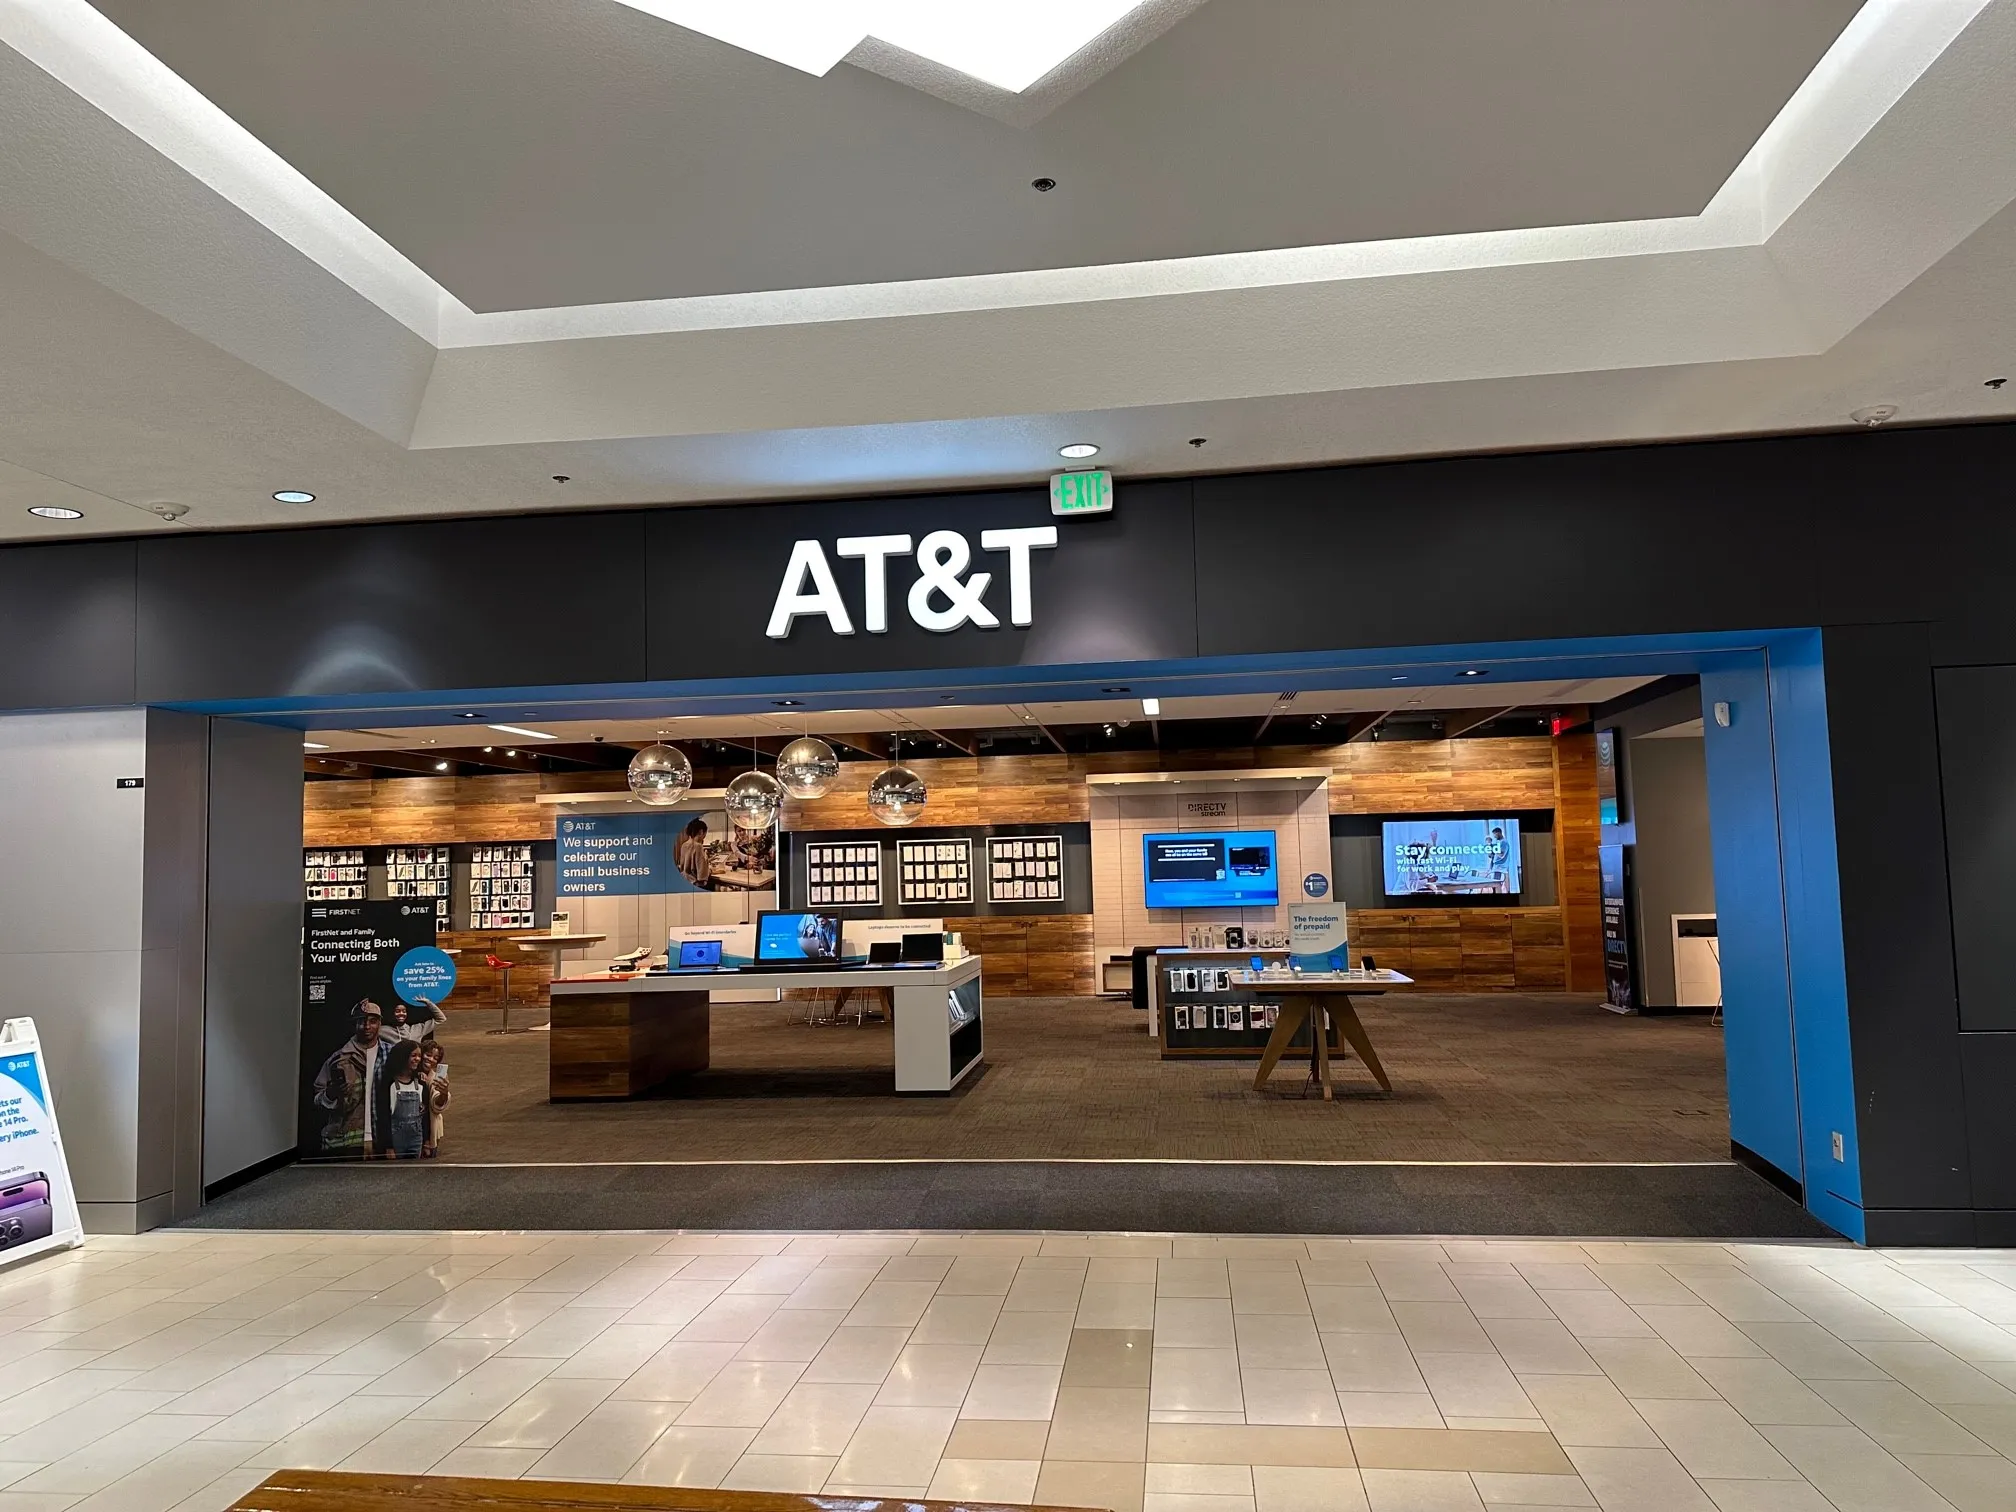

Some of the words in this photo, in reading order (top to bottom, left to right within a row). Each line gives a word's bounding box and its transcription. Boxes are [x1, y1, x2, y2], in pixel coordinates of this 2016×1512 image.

[1060, 472, 1103, 510] EXIT
[765, 525, 1058, 639] AT&T
[125, 779, 136, 787] 179
[1188, 803, 1226, 812] DIRECTV
[575, 822, 596, 831] AT&T
[563, 837, 581, 848] We
[584, 836, 630, 849] support
[632, 835, 653, 846] and
[1395, 844, 1427, 858] Stay
[1429, 842, 1501, 855] connected
[563, 852, 616, 863] celebrate
[619, 852, 638, 861] our
[1396, 857, 1416, 865] with
[1416, 857, 1434, 865] fast
[1435, 856, 1457, 864] Wi-Fi
[563, 867, 595, 878] small
[597, 866, 650, 877] business
[1411, 864, 1433, 872] work
[1451, 864, 1470, 873] play
[563, 883, 606, 893] owners
[329, 908, 361, 916] FIRSTNET
[1303, 923, 1330, 931] prepaid
[310, 940, 371, 950] Connecting
[373, 938, 400, 948] Both
[310, 953, 336, 963] Your
[339, 952, 378, 962] Worlds
[425, 966, 445, 974] 25%
[16, 1060, 30, 1069] AT&T
[10, 1097, 22, 1105] our
[7, 1106, 20, 1115] the
[4, 1117, 13, 1126] 14
[13, 1116, 29, 1124] Pro.
[12, 1128, 40, 1139] iPhone.
